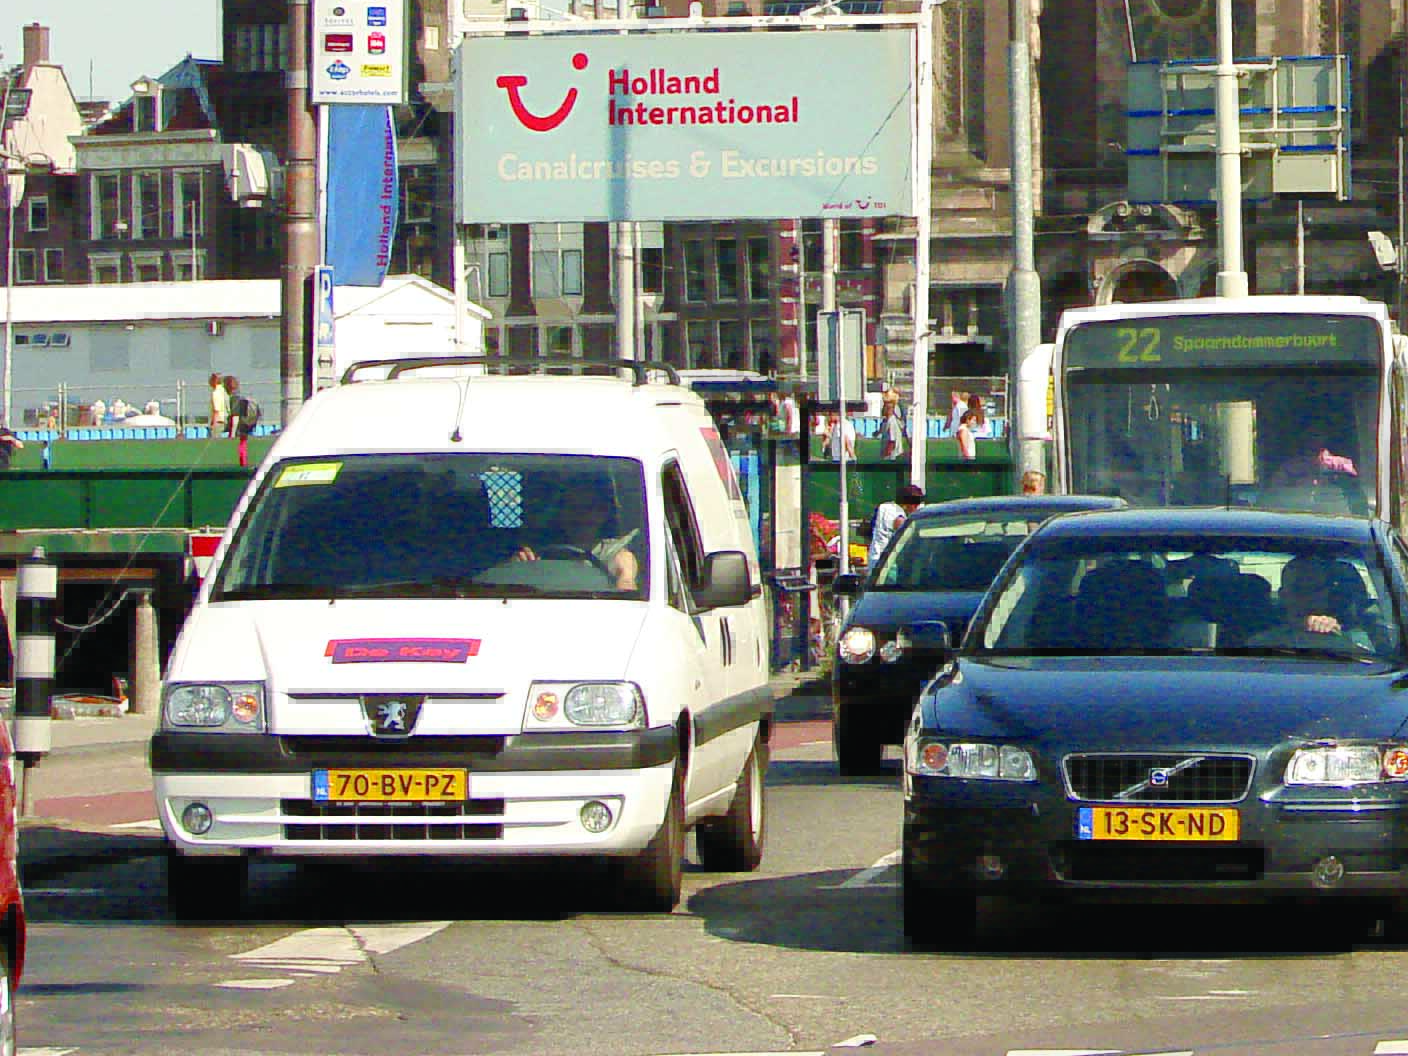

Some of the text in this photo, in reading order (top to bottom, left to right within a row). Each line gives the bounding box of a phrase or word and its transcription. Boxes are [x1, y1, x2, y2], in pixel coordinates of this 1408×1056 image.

[608, 68, 720, 95] Holland
[608, 96, 799, 126] International
[498, 149, 879, 181] Canalcruises & Excursions
[376, 206, 392, 267] Holland
[1118, 328, 1338, 362] 22 Spaarndammerbuurt
[337, 774, 456, 797] 70-BV-PZ
[1104, 811, 1226, 836] 13-SK-ND
